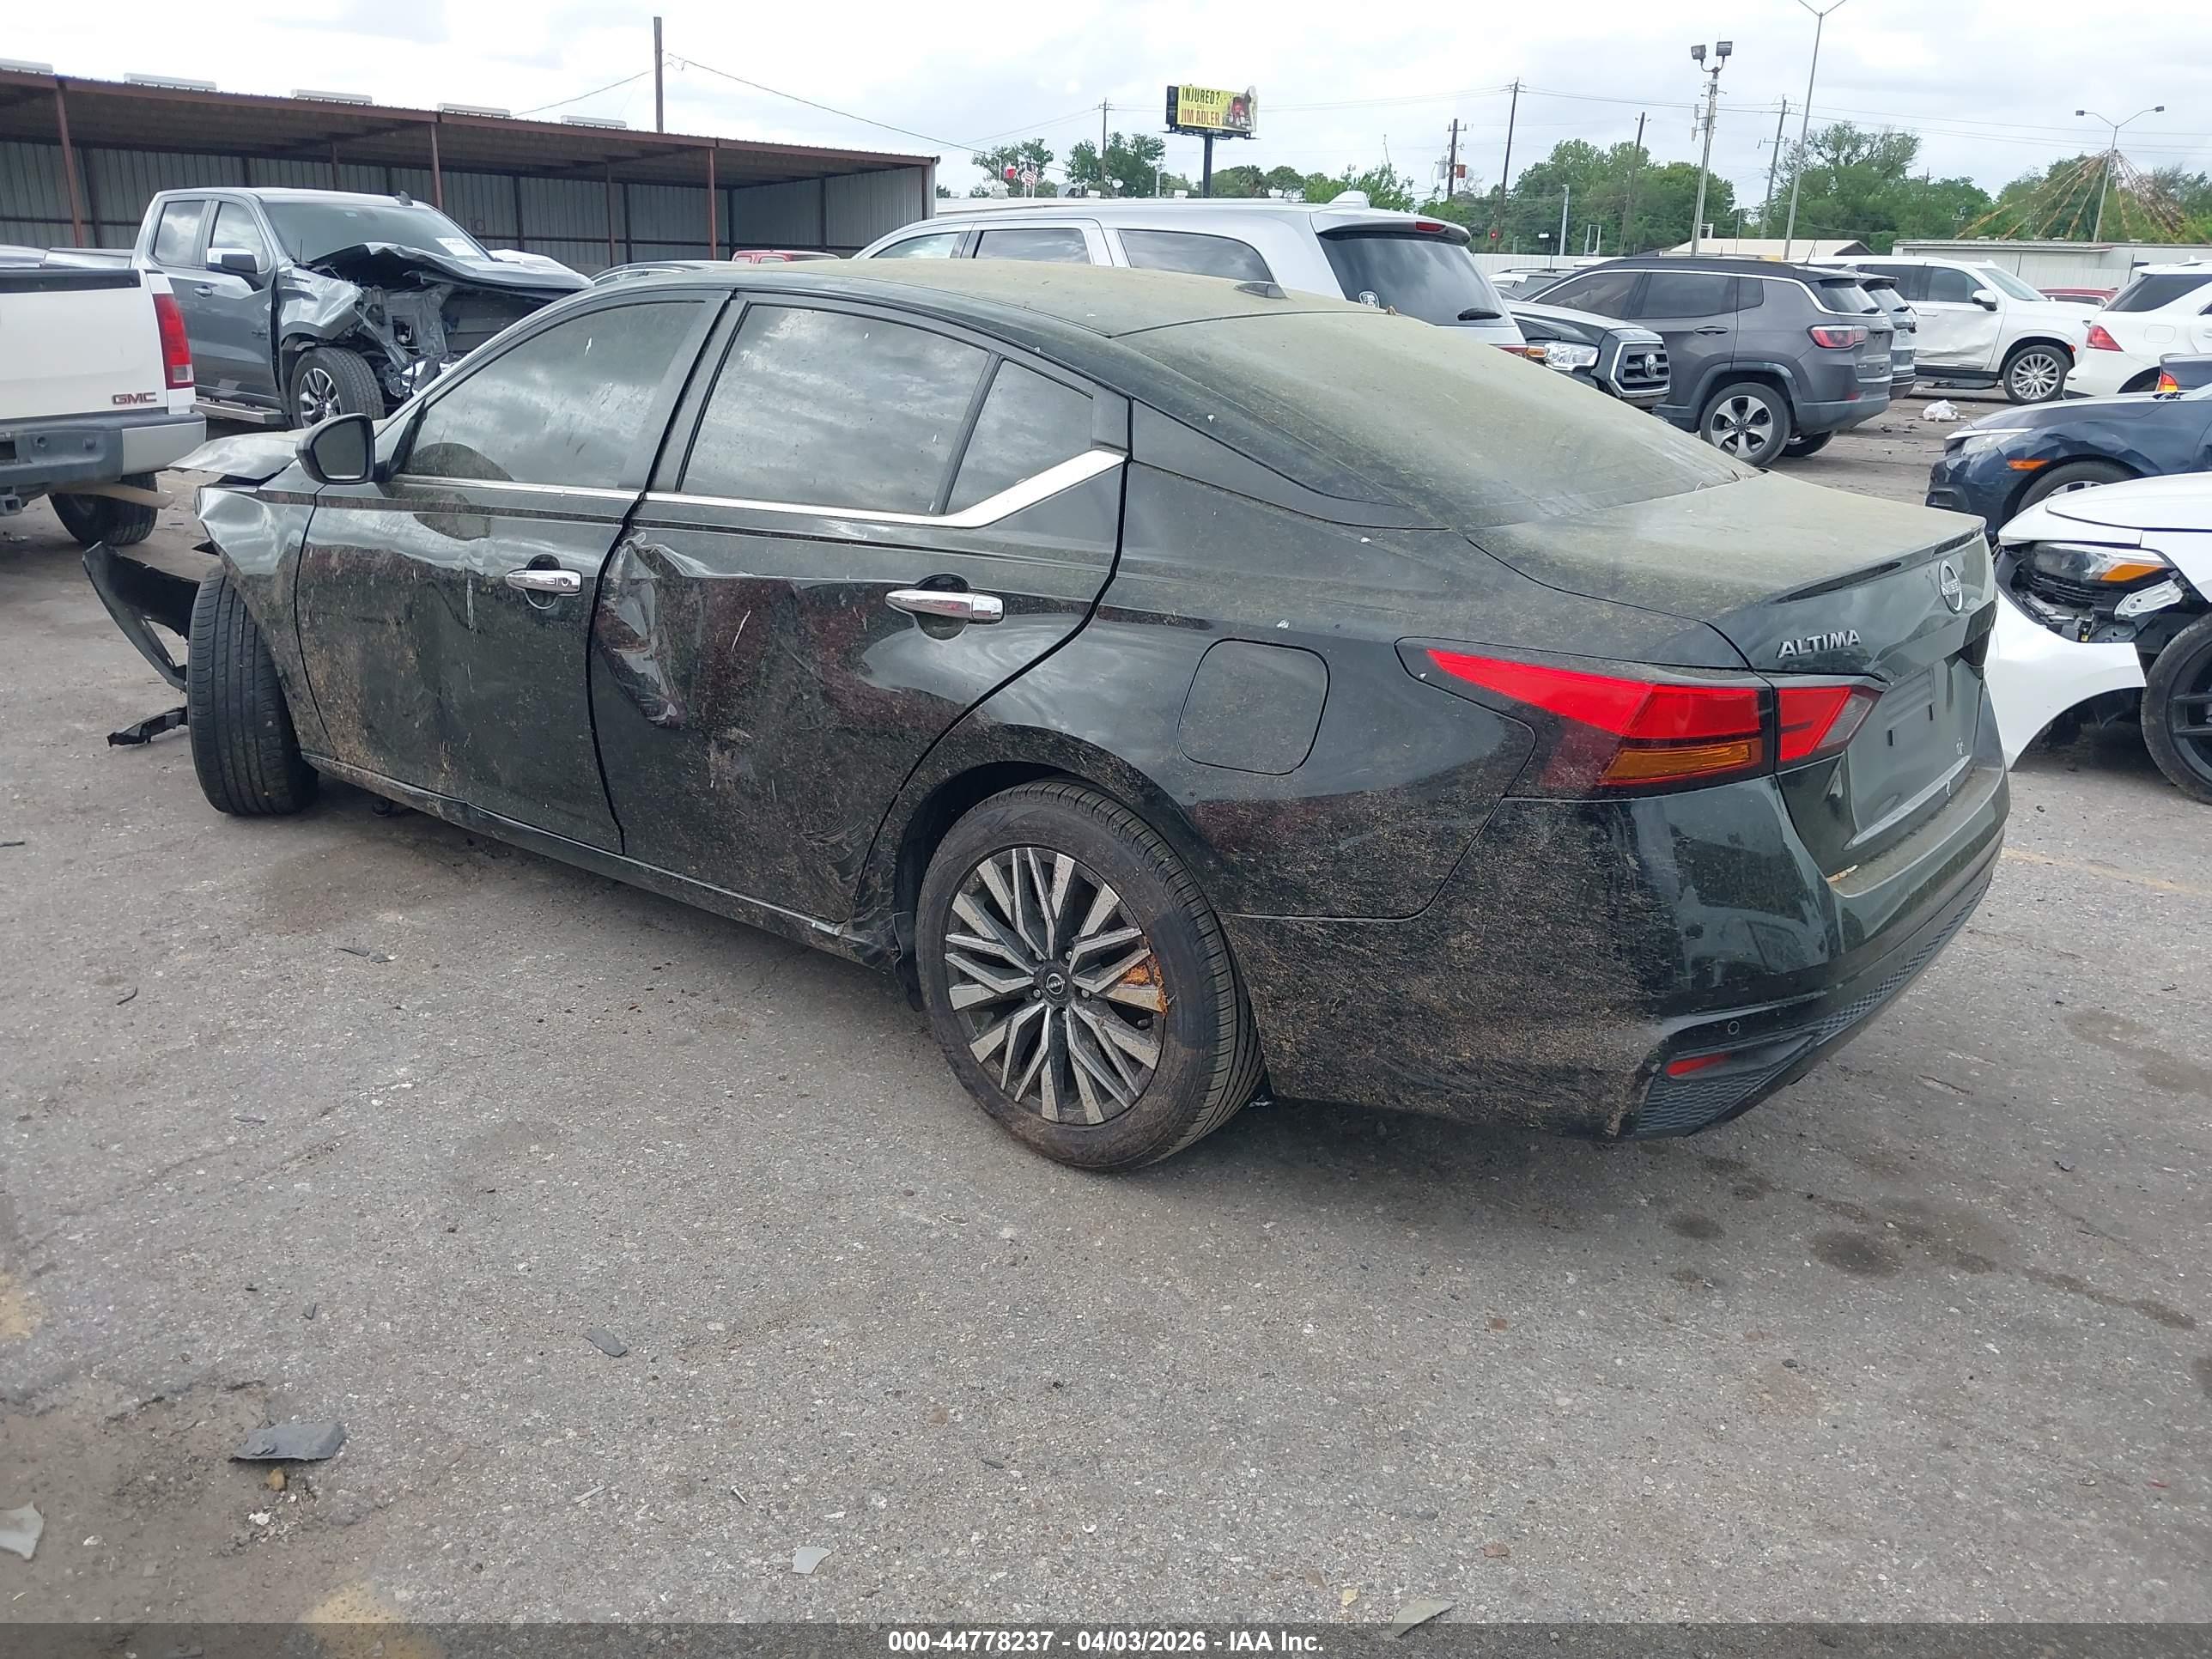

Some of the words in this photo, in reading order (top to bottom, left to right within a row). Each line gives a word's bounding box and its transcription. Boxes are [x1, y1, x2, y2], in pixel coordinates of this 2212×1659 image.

[1182, 87, 1220, 105] INJURED?
[1181, 108, 1194, 124] JIM
[1195, 110, 1220, 126] ADLER
[112, 392, 157, 404] GMC
[1777, 629, 1862, 659] ALTIMA
